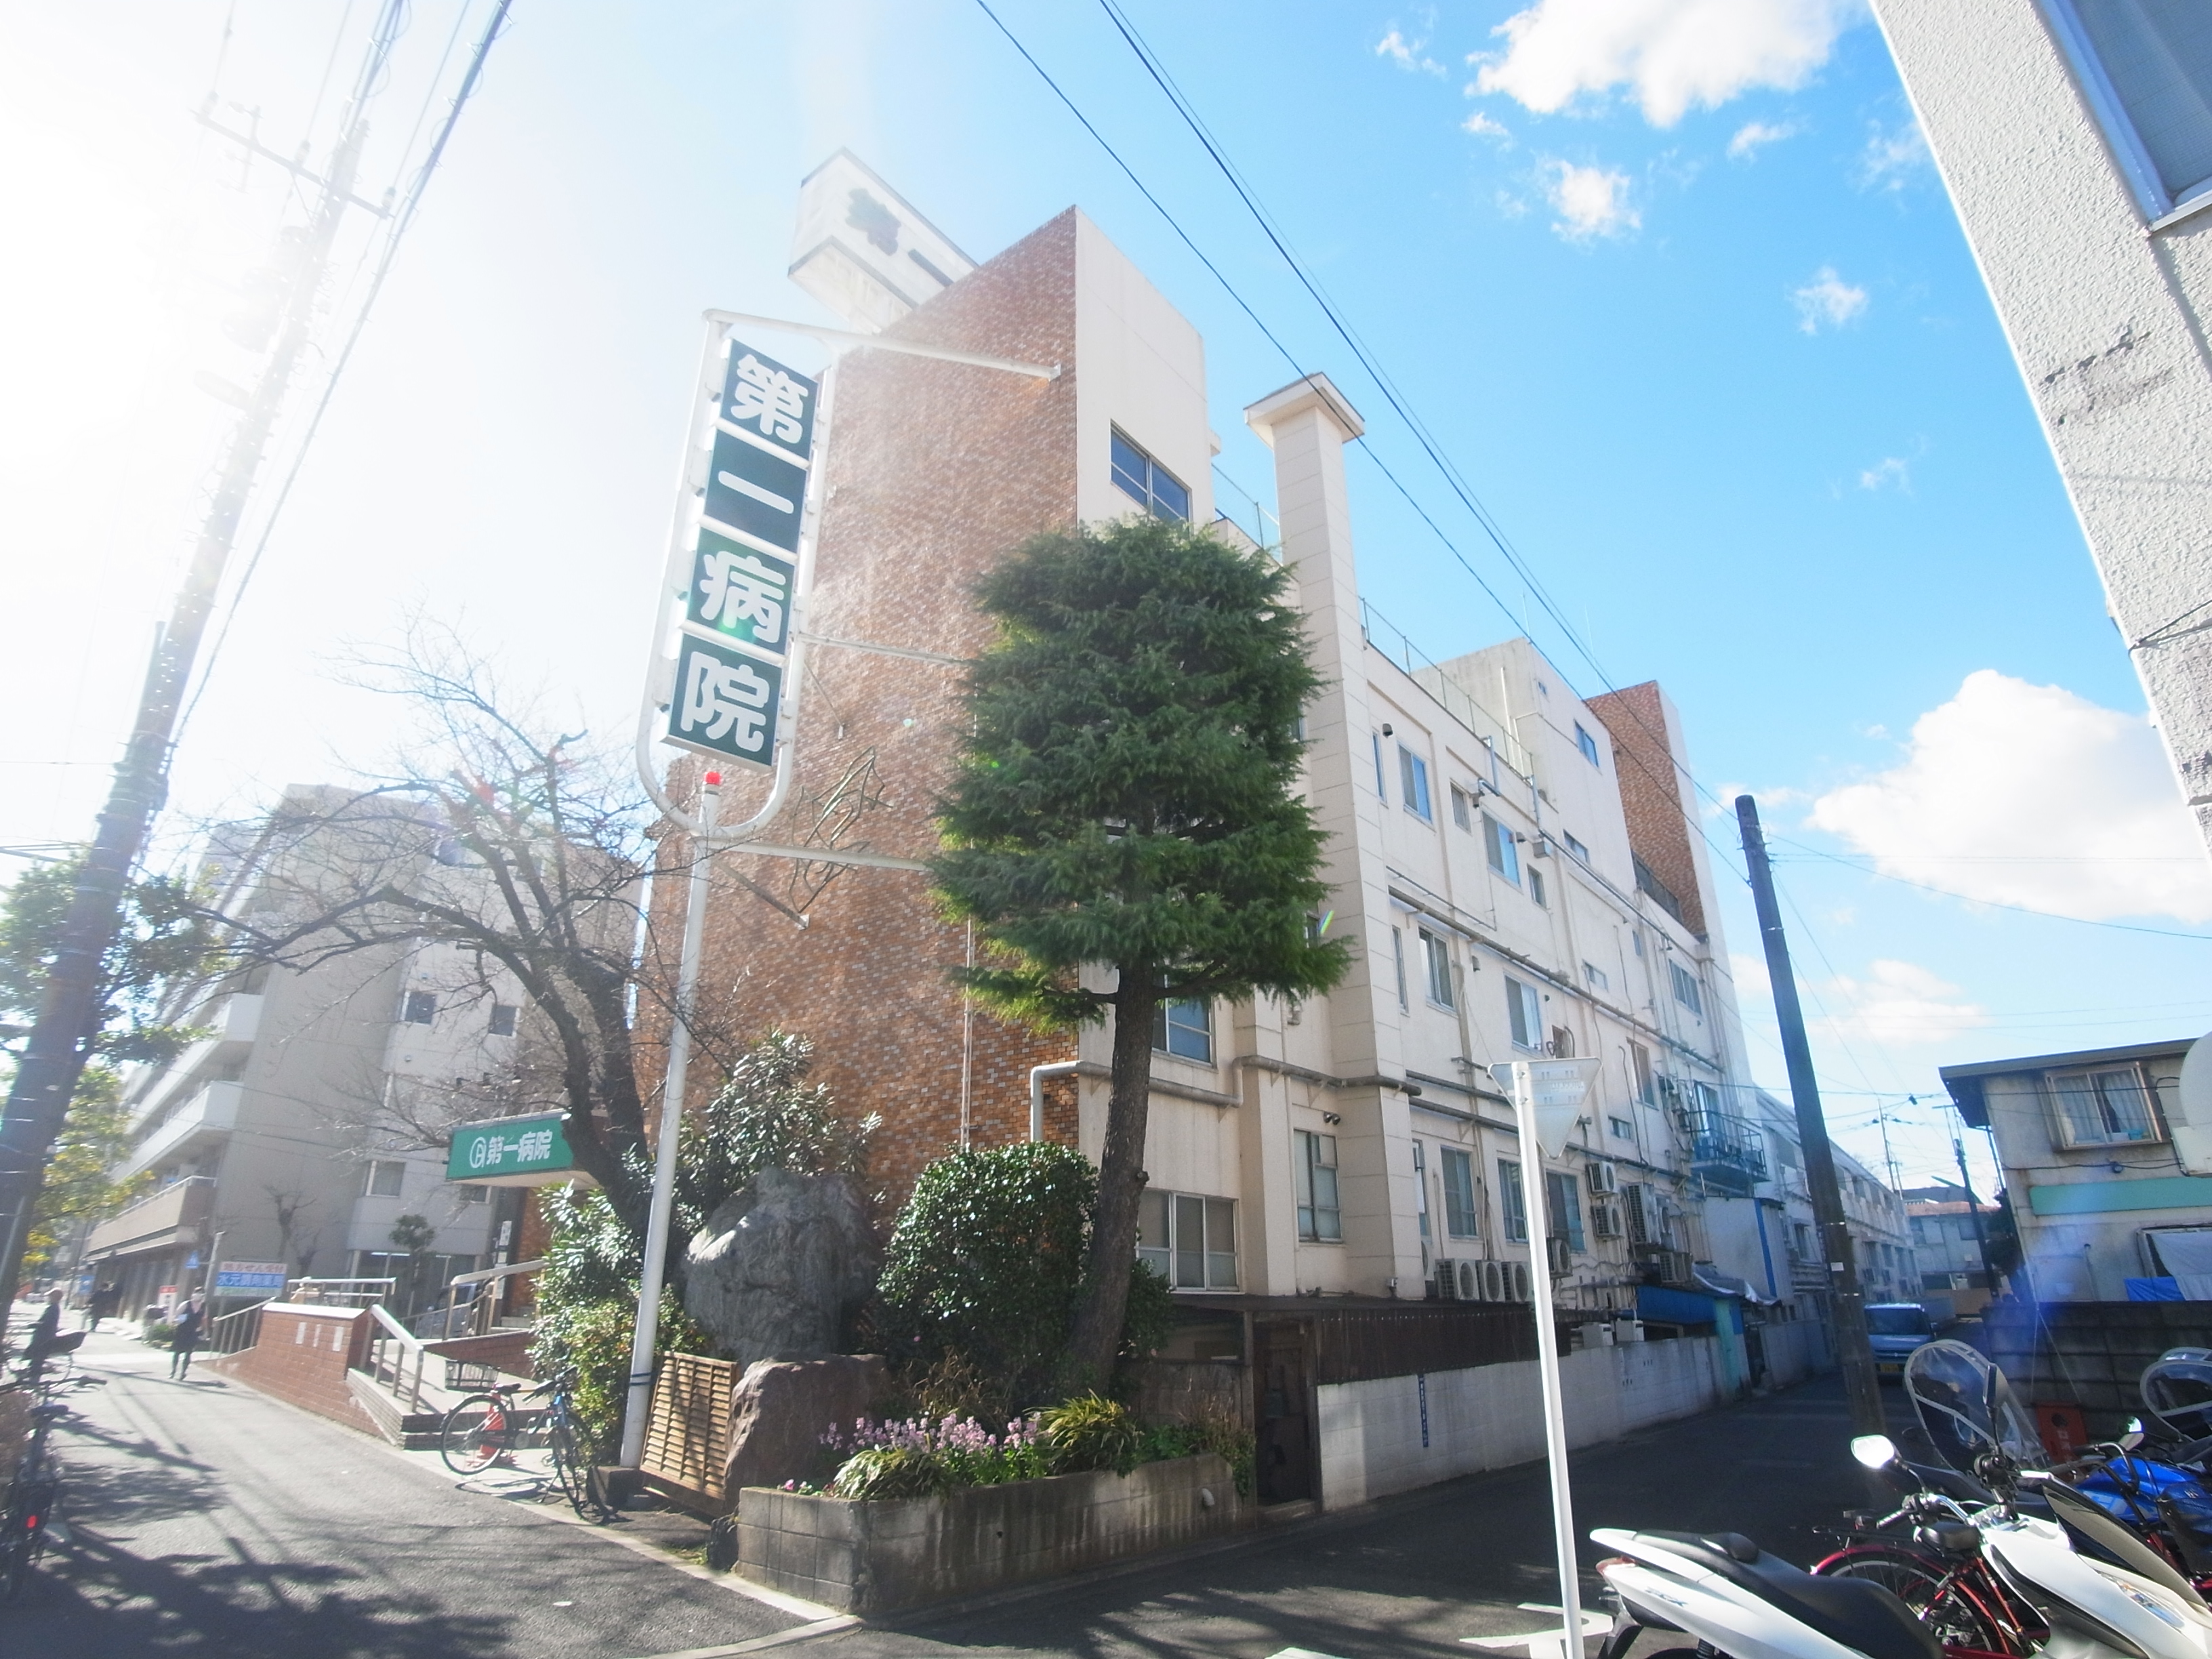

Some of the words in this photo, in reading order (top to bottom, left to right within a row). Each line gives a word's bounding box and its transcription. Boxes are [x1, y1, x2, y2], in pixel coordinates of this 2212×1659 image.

[679, 352, 810, 754] 第一病院
[486, 1129, 553, 1165] 第一病院
